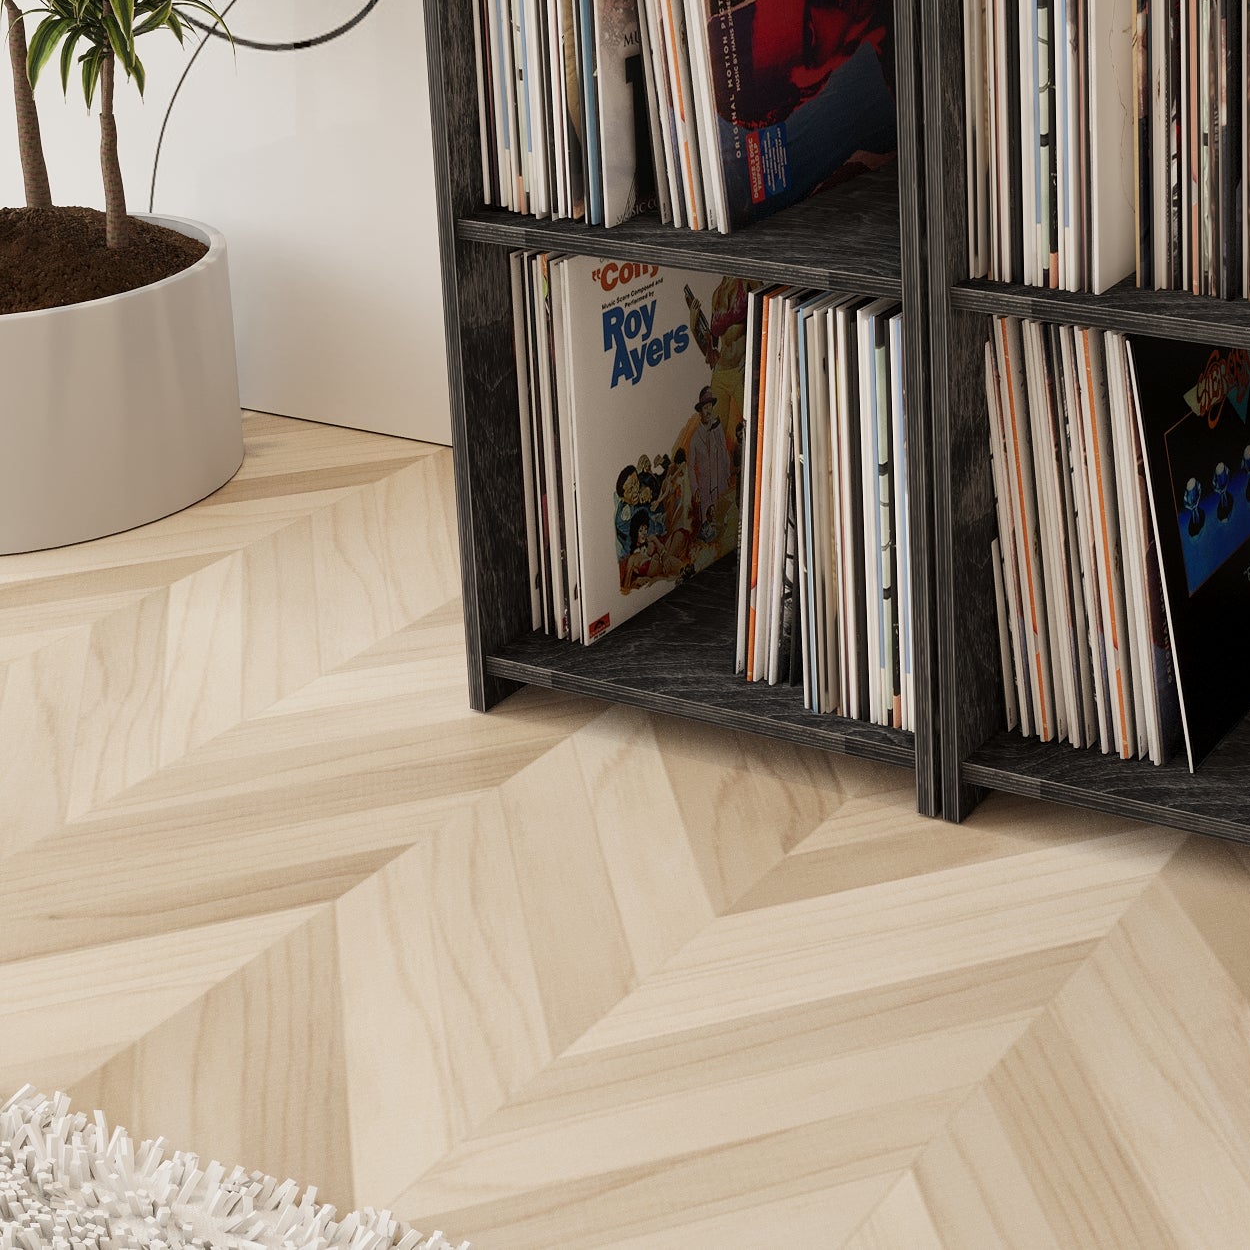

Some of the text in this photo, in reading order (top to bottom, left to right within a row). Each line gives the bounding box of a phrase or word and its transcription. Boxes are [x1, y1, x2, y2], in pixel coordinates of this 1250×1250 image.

[729, 27, 737, 52] HANS
[721, 35, 734, 88] MOTION
[731, 52, 738, 65] BY
[732, 65, 741, 92] MUSIC
[729, 94, 742, 159] ORIGINAL
[748, 137, 756, 158] DISC
[750, 165, 759, 199] DELUXE
[601, 299, 616, 310] Music
[616, 293, 630, 304] Score
[630, 282, 655, 297] Composed
[624, 294, 650, 309] Performed
[602, 299, 657, 352] Roy
[610, 324, 690, 389] Ayers
